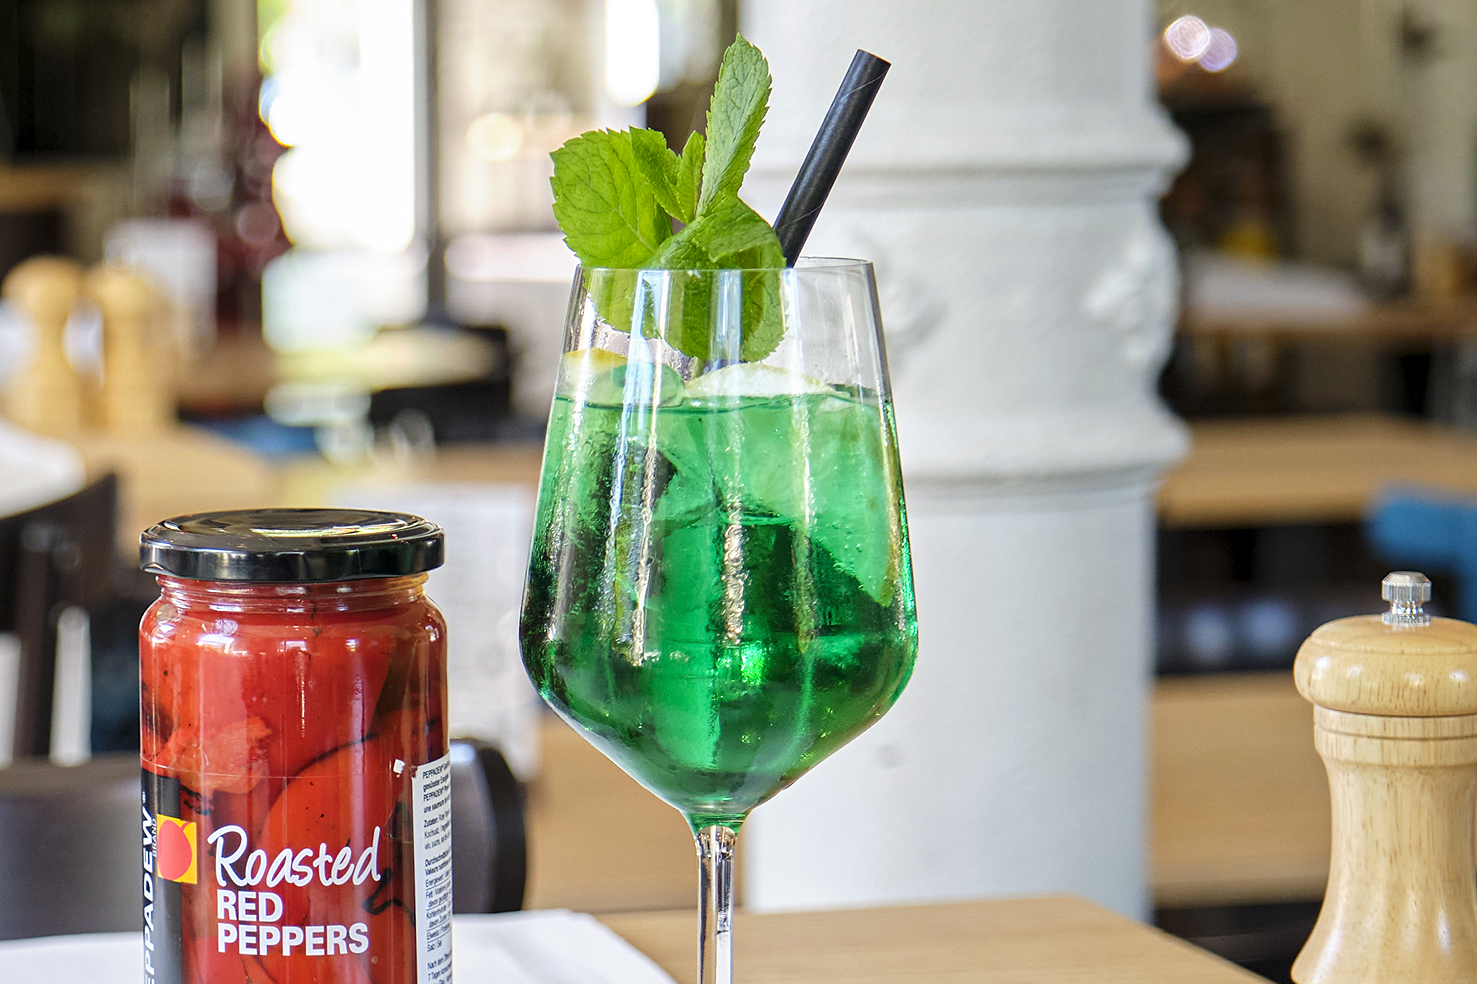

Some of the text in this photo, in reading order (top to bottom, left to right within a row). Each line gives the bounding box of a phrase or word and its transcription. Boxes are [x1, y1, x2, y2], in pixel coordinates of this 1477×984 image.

[207, 825, 381, 887] Roasted
[217, 889, 283, 922] RED
[218, 922, 369, 956] PEPPERS
